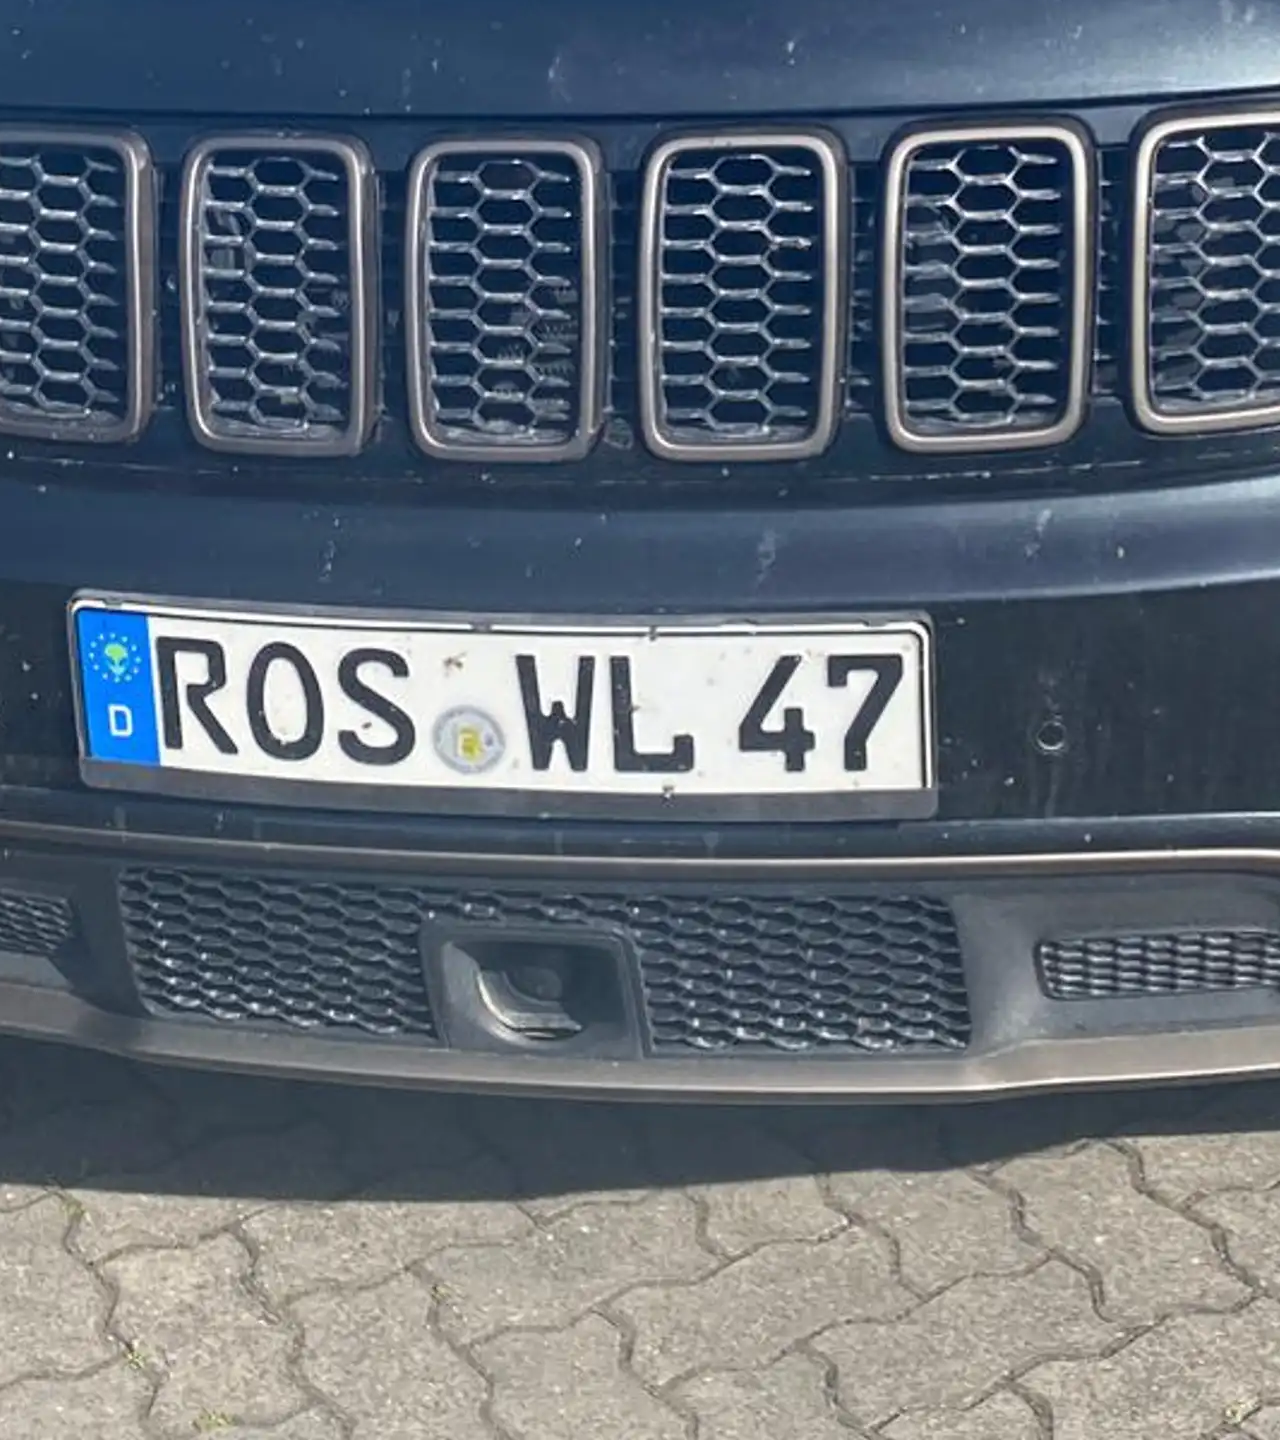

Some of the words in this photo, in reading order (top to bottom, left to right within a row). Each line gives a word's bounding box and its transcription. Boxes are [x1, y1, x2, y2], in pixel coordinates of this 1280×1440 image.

[108, 703, 133, 737] D
[155, 635, 417, 766] ROS
[515, 654, 694, 772] WL
[738, 653, 904, 772] 47
